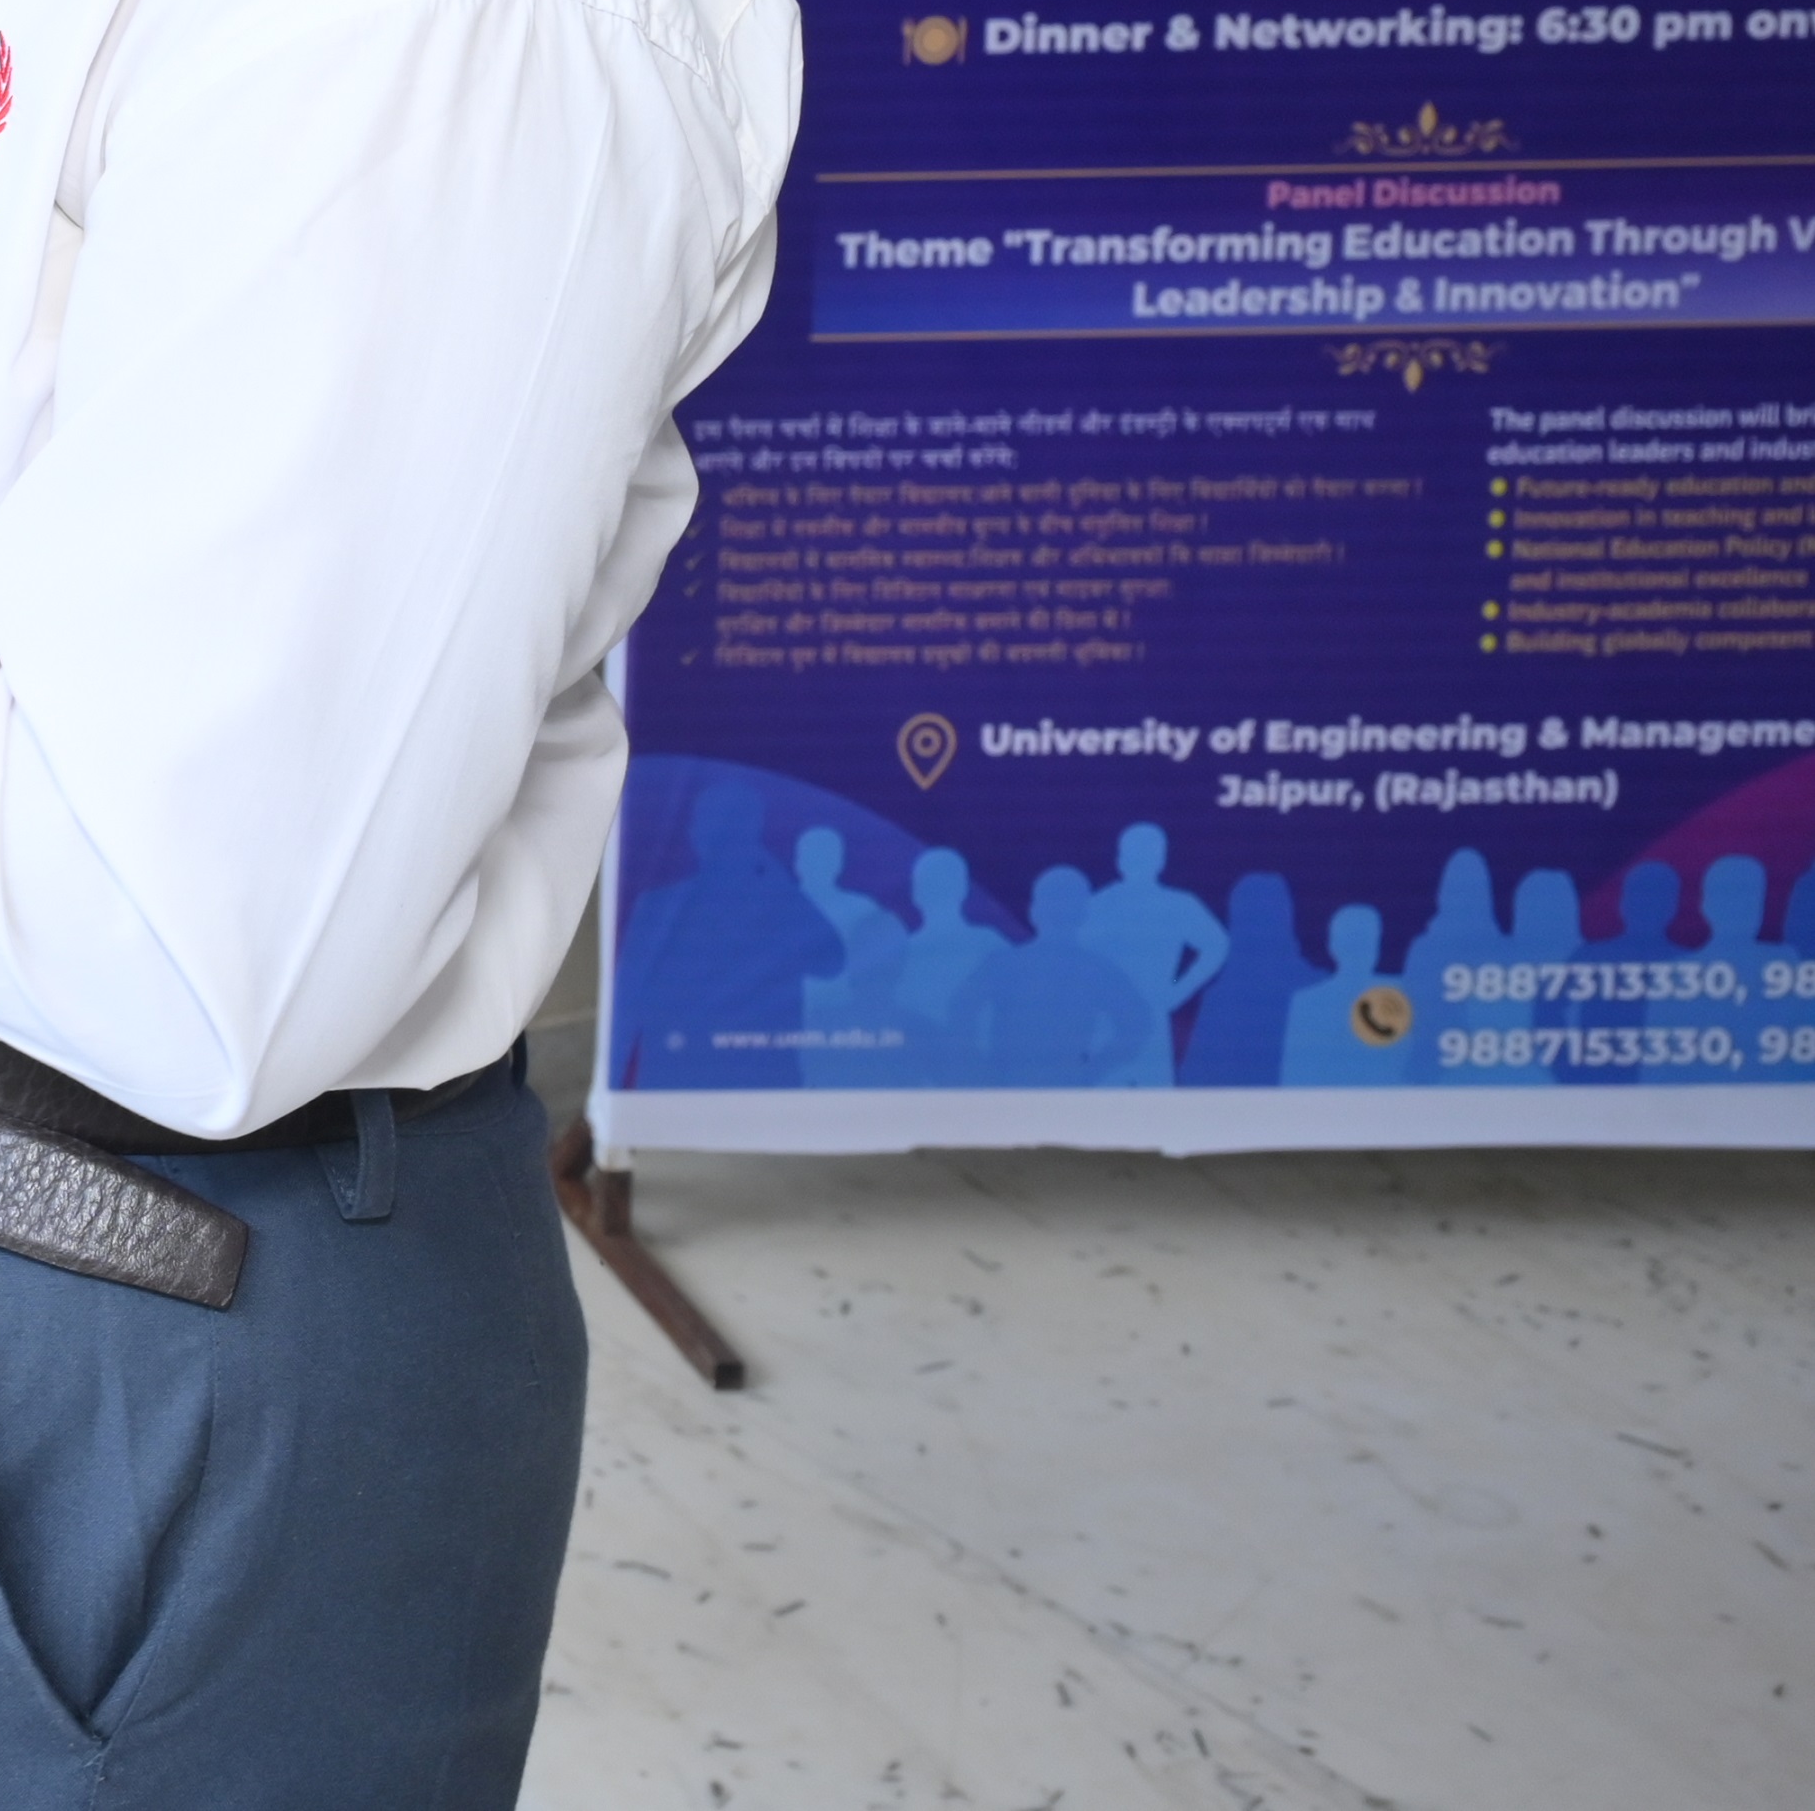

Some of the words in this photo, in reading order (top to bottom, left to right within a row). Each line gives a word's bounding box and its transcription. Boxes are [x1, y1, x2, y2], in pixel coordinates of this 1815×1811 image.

[984, 13, 1151, 56] Dinner
[1164, 13, 1200, 52] &
[1213, 5, 1522, 54] Networking:
[1535, 4, 1640, 47] 6:30
[1652, 9, 1734, 51] pm
[1745, 8, 1815, 41] on
[1268, 178, 1366, 210] Panel
[1372, 173, 1561, 209] Discussion
[837, 231, 993, 270] Theme
[1002, 223, 1333, 271] "Transforming
[1342, 220, 1575, 263] Education
[1586, 213, 1778, 262] Through
[1132, 278, 1385, 326] Leadership
[1395, 277, 1426, 313] &
[1489, 406, 1535, 433] The
[1538, 404, 1606, 436] panel
[1609, 403, 1733, 432] discussion
[1737, 401, 1780, 429] will
[1486, 437, 1602, 466] education
[1607, 437, 1695, 465] leaders
[1698, 435, 1745, 463] and
[979, 719, 1200, 763] University
[1209, 718, 1257, 755] of
[1265, 712, 1528, 761] Engineering
[1538, 715, 1570, 749] &
[1216, 768, 1365, 814] Jaipur,
[1374, 767, 1620, 812] (Rajasthan)
[1442, 961, 1748, 1007] 9887313330,
[1438, 1026, 1745, 1072] 9887153330,
